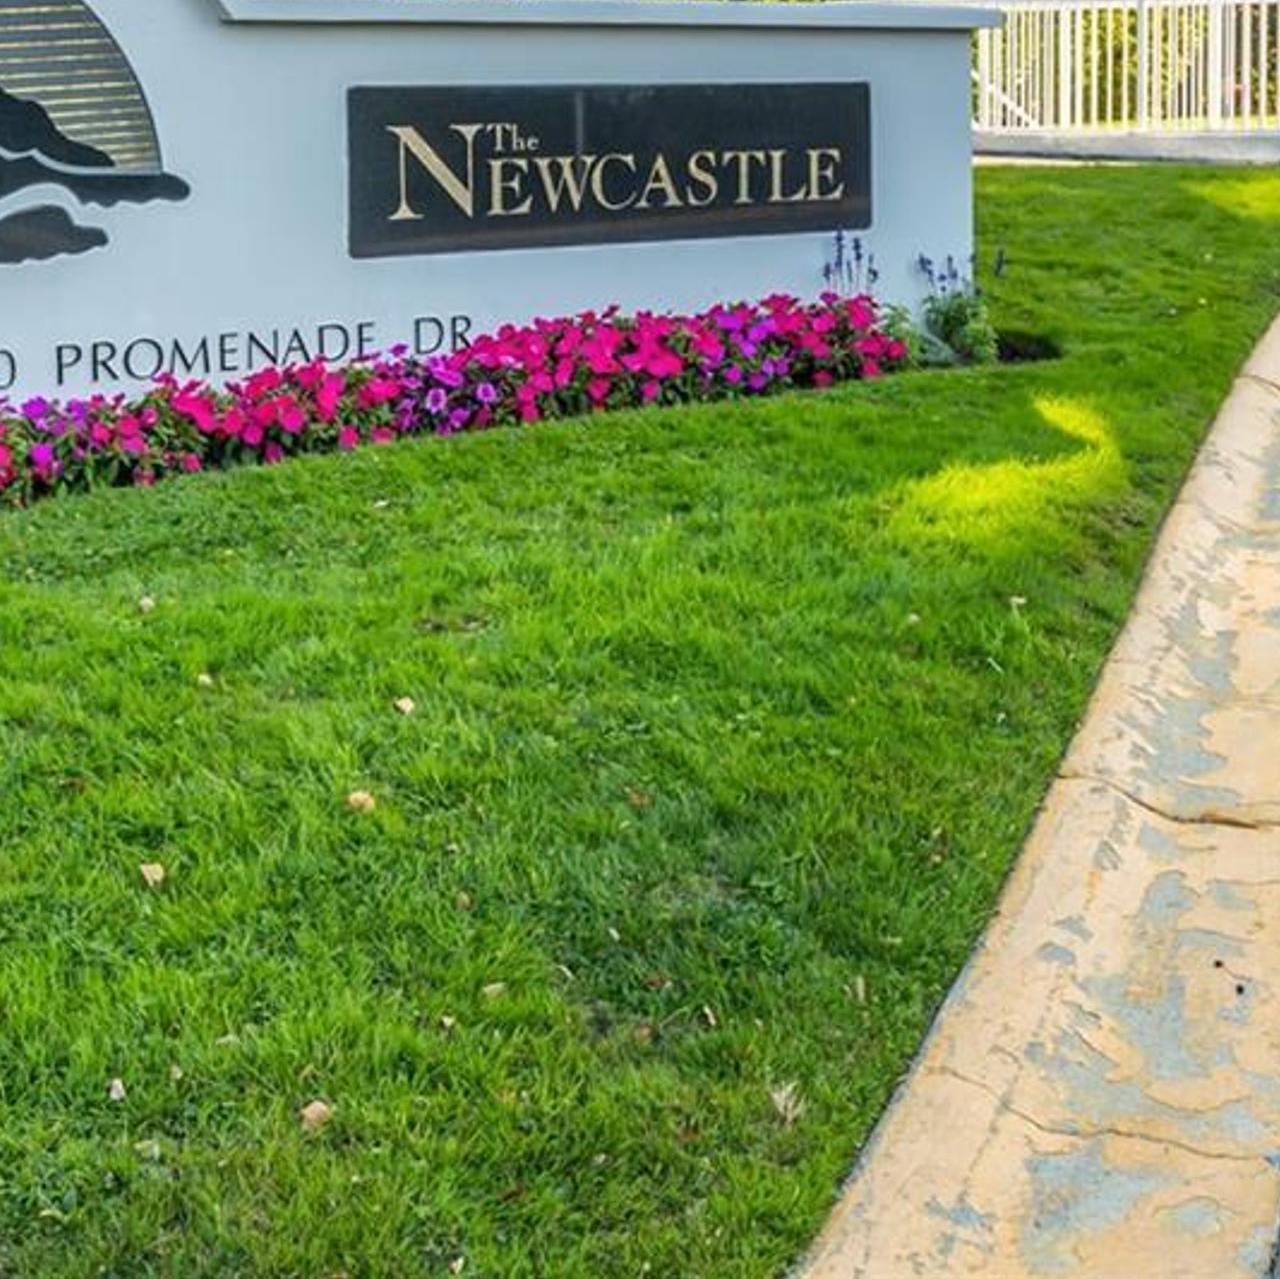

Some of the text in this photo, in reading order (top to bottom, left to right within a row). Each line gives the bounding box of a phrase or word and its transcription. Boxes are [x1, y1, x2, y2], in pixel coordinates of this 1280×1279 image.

[386, 123, 845, 220] NEWCASTLE
[487, 123, 540, 152] The
[55, 322, 376, 386] PROMENADE
[413, 315, 472, 355] DR
